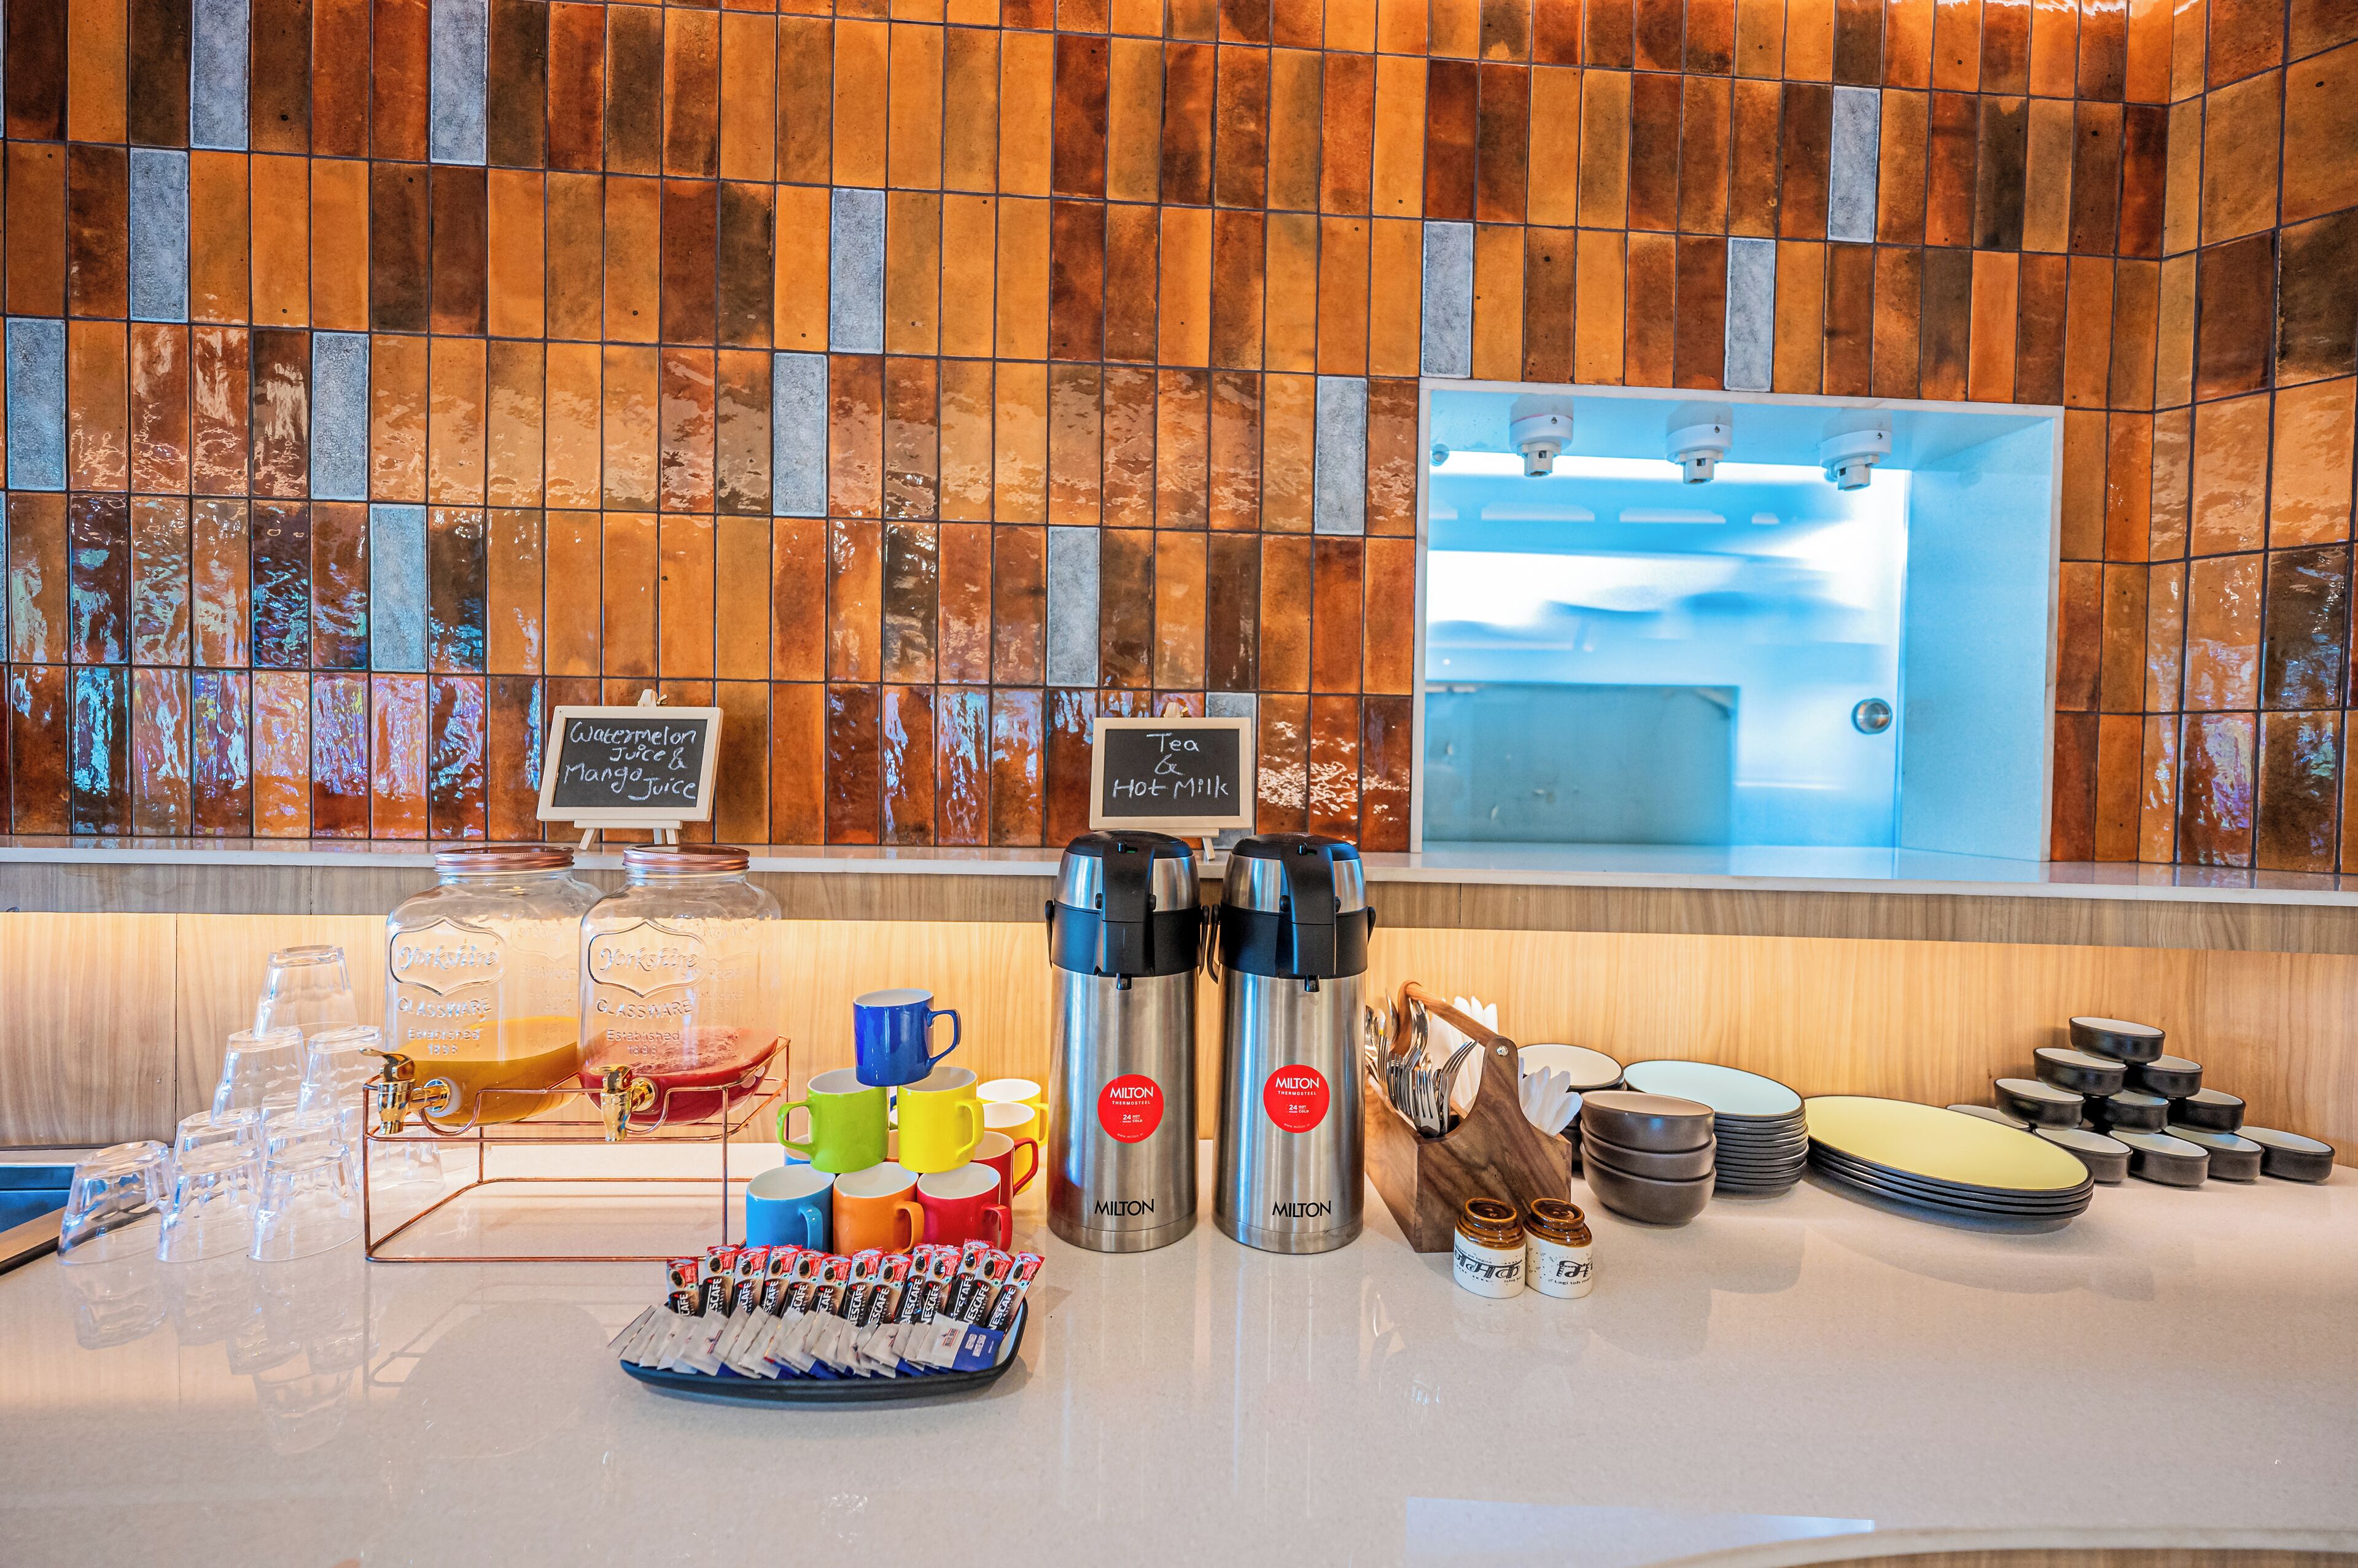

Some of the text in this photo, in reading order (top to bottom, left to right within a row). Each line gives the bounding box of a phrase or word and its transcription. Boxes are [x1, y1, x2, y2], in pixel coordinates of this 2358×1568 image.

[570, 721, 697, 745] Watermelon
[1146, 732, 1200, 754] Tea
[609, 743, 688, 770] Juice &
[1154, 753, 1185, 775] &
[563, 762, 696, 801] Mango Juice
[1112, 774, 1229, 800] Hot Milk
[399, 945, 498, 971] Yorkshire
[599, 947, 698, 972] Yorkshire
[398, 998, 492, 1018] GLASSWARE
[596, 999, 693, 1019] GLASSWARE
[606, 1029, 680, 1042] Established
[1110, 1086, 1154, 1098] MILTON
[1275, 1077, 1320, 1089] MILTON
[1094, 1198, 1154, 1216] MILTON
[1272, 1200, 1331, 1217] MILTON
[975, 1297, 989, 1321] CLASSIC
